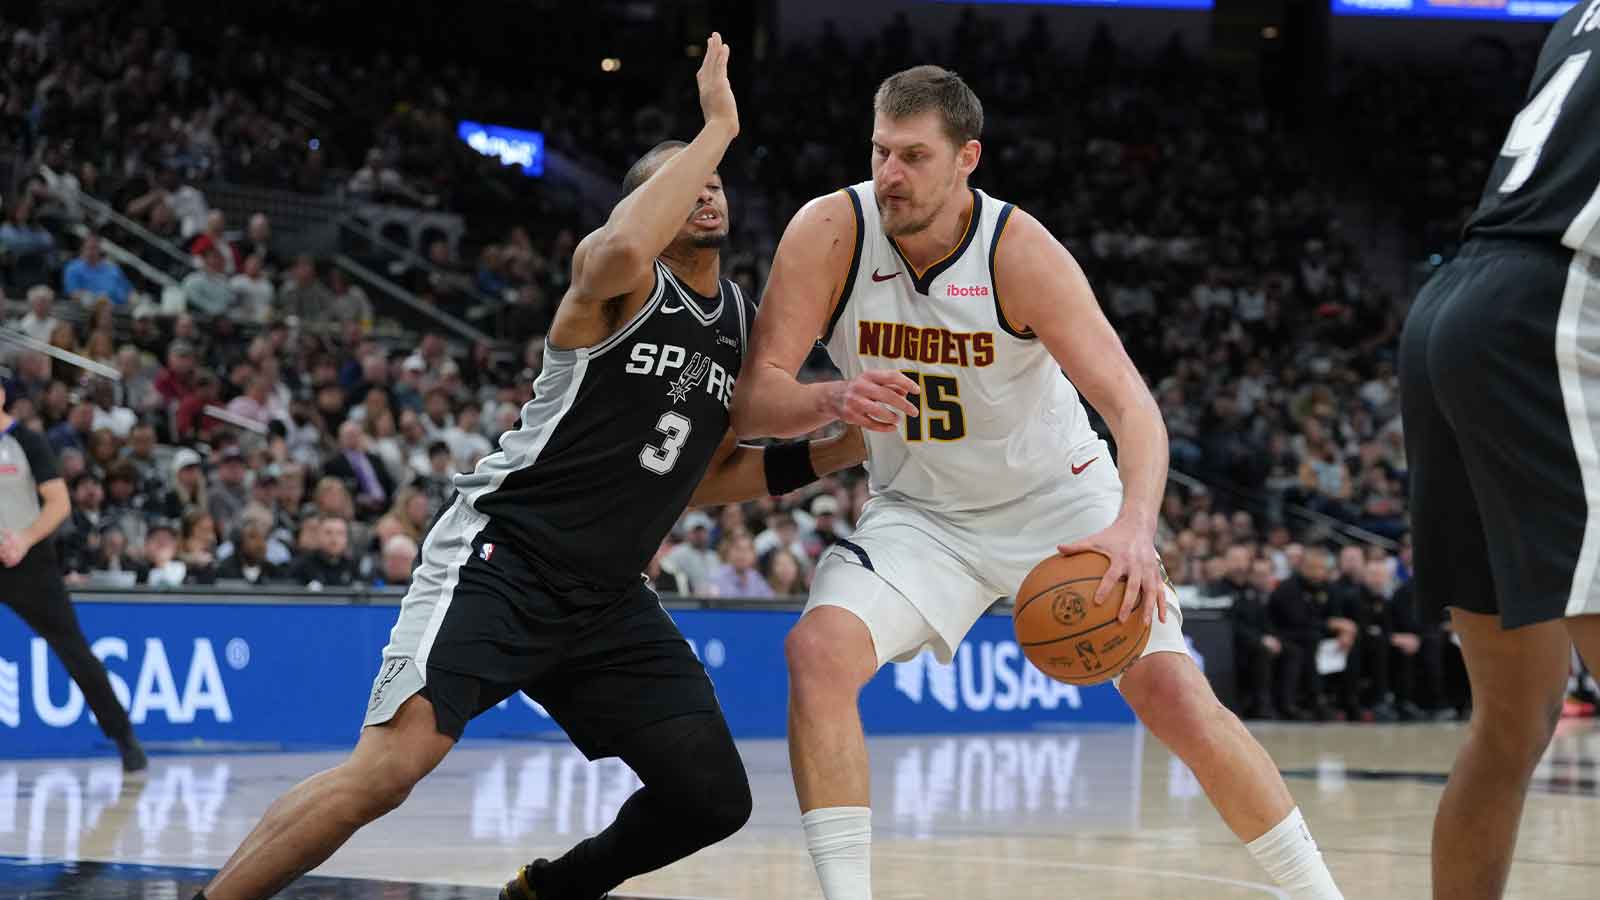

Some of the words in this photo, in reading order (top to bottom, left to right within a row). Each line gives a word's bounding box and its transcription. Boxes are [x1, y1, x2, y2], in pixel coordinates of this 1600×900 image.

[1498, 50, 1592, 193] 4
[946, 284, 989, 297] ibotta
[858, 320, 995, 368] NUGGETS
[899, 369, 967, 443] 15
[638, 410, 692, 476] 3
